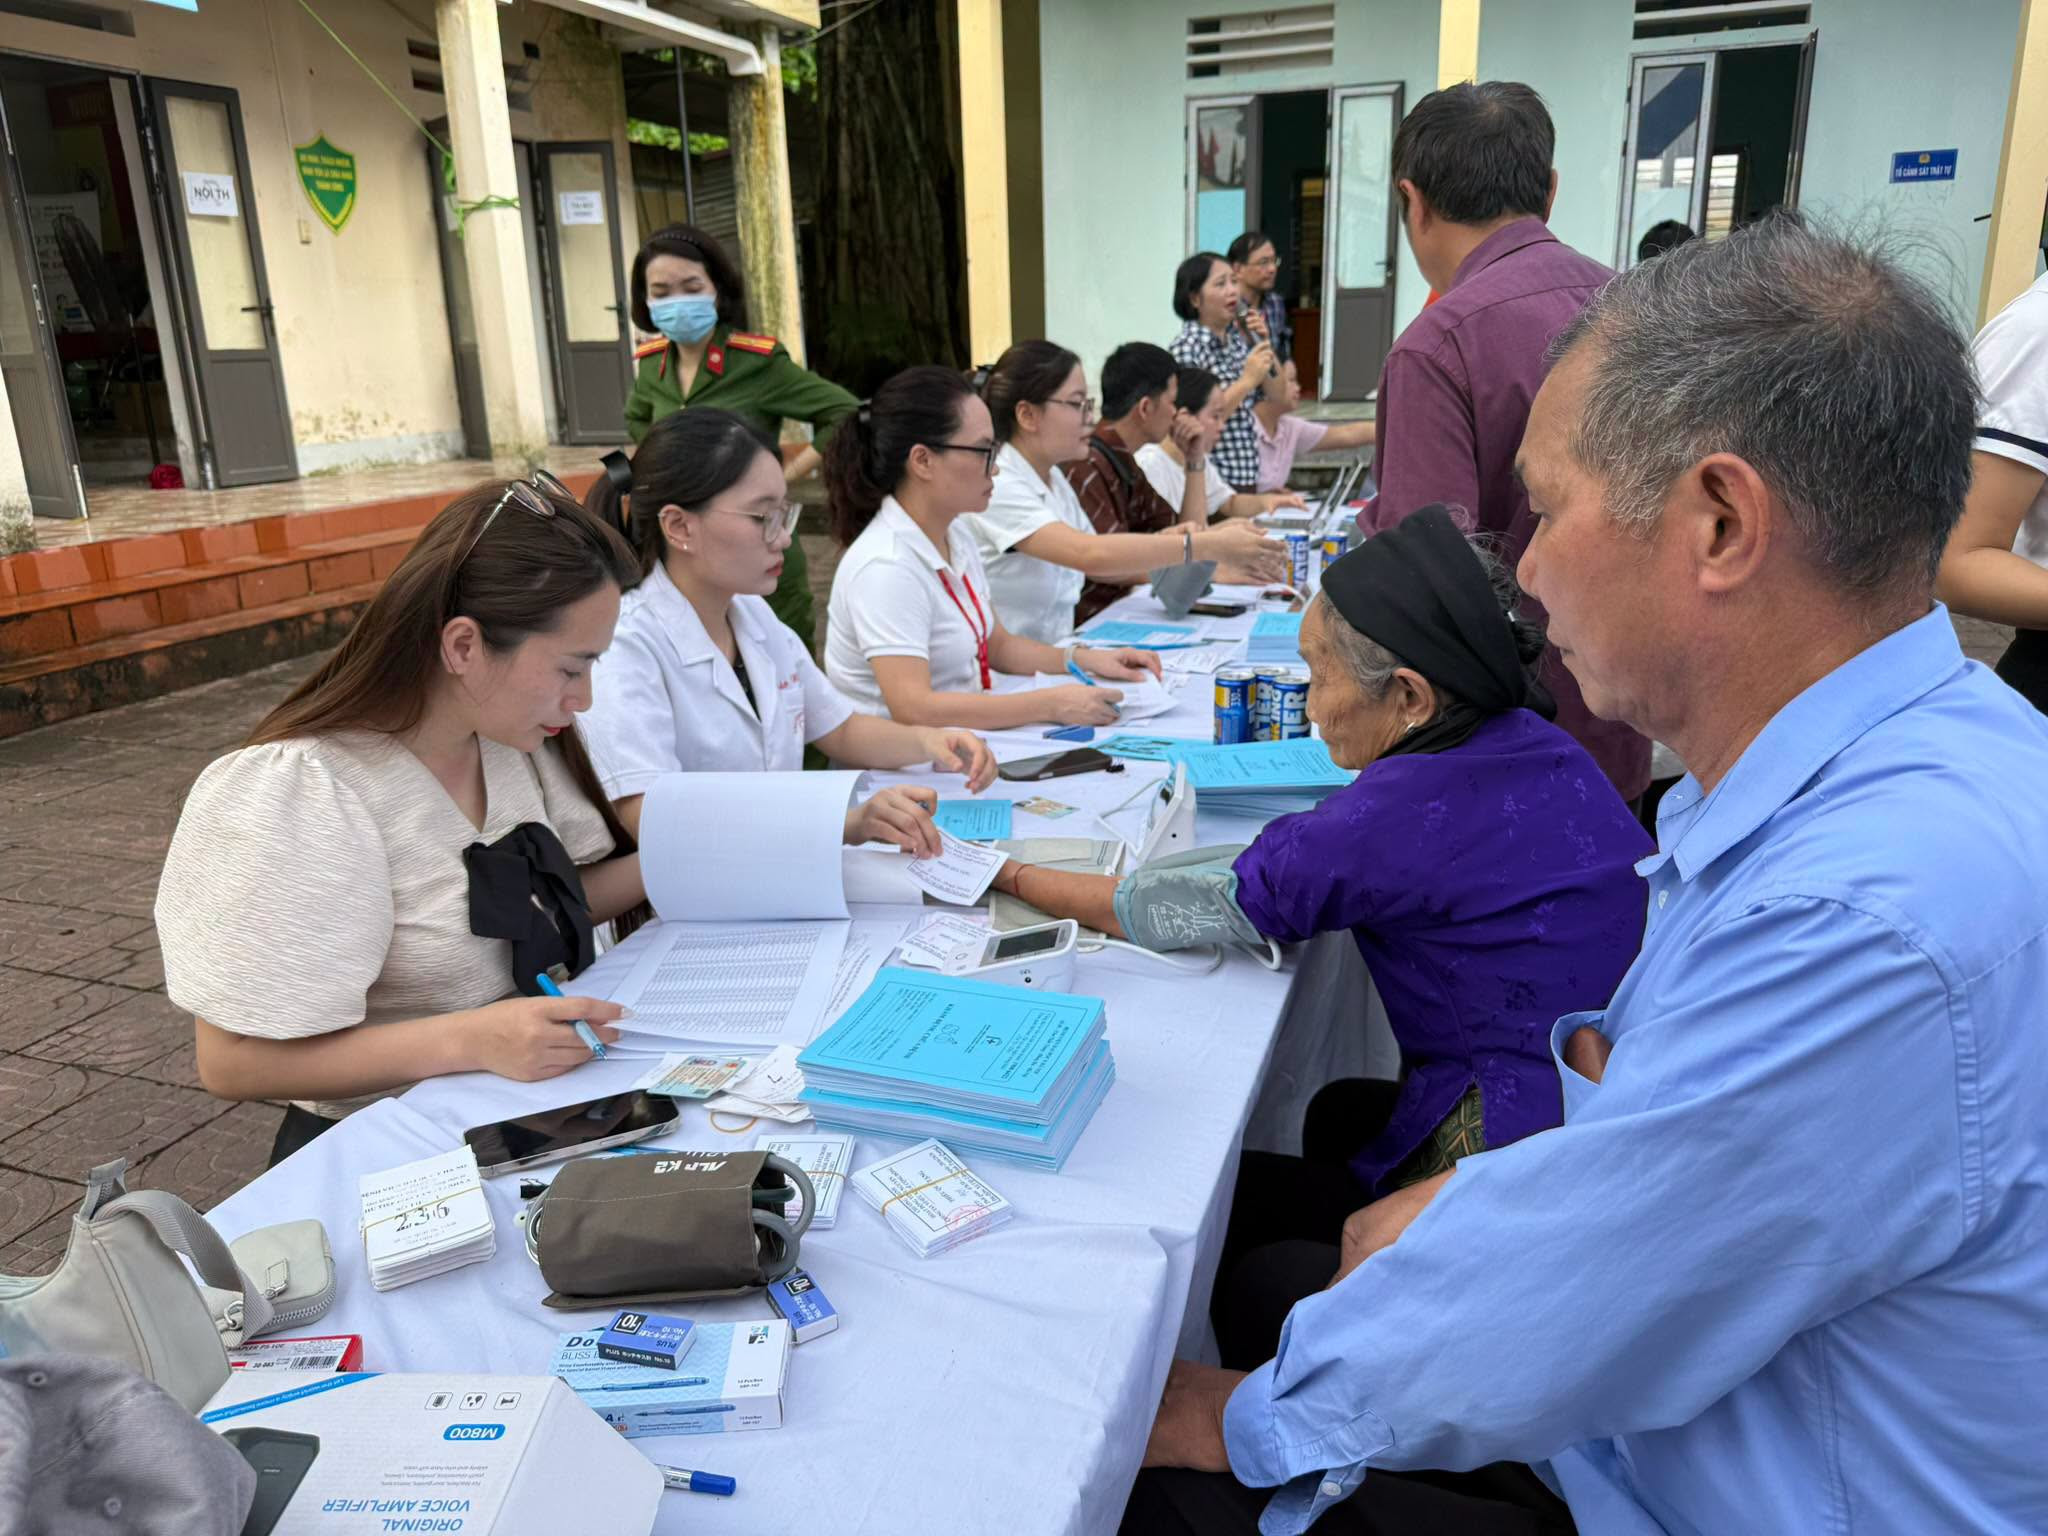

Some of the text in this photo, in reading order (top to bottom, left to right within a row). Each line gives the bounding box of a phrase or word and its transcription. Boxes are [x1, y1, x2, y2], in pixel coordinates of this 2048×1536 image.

[621, 1313, 639, 1328] 10
[656, 1339, 677, 1349] PLUS
[561, 1350, 591, 1360] BLISS
[605, 1348, 621, 1356] PLUS
[449, 1426, 499, 1439] M800
[322, 1498, 472, 1513] VOICE AMPLIFIER
[382, 1517, 463, 1532] ORIGINAL
